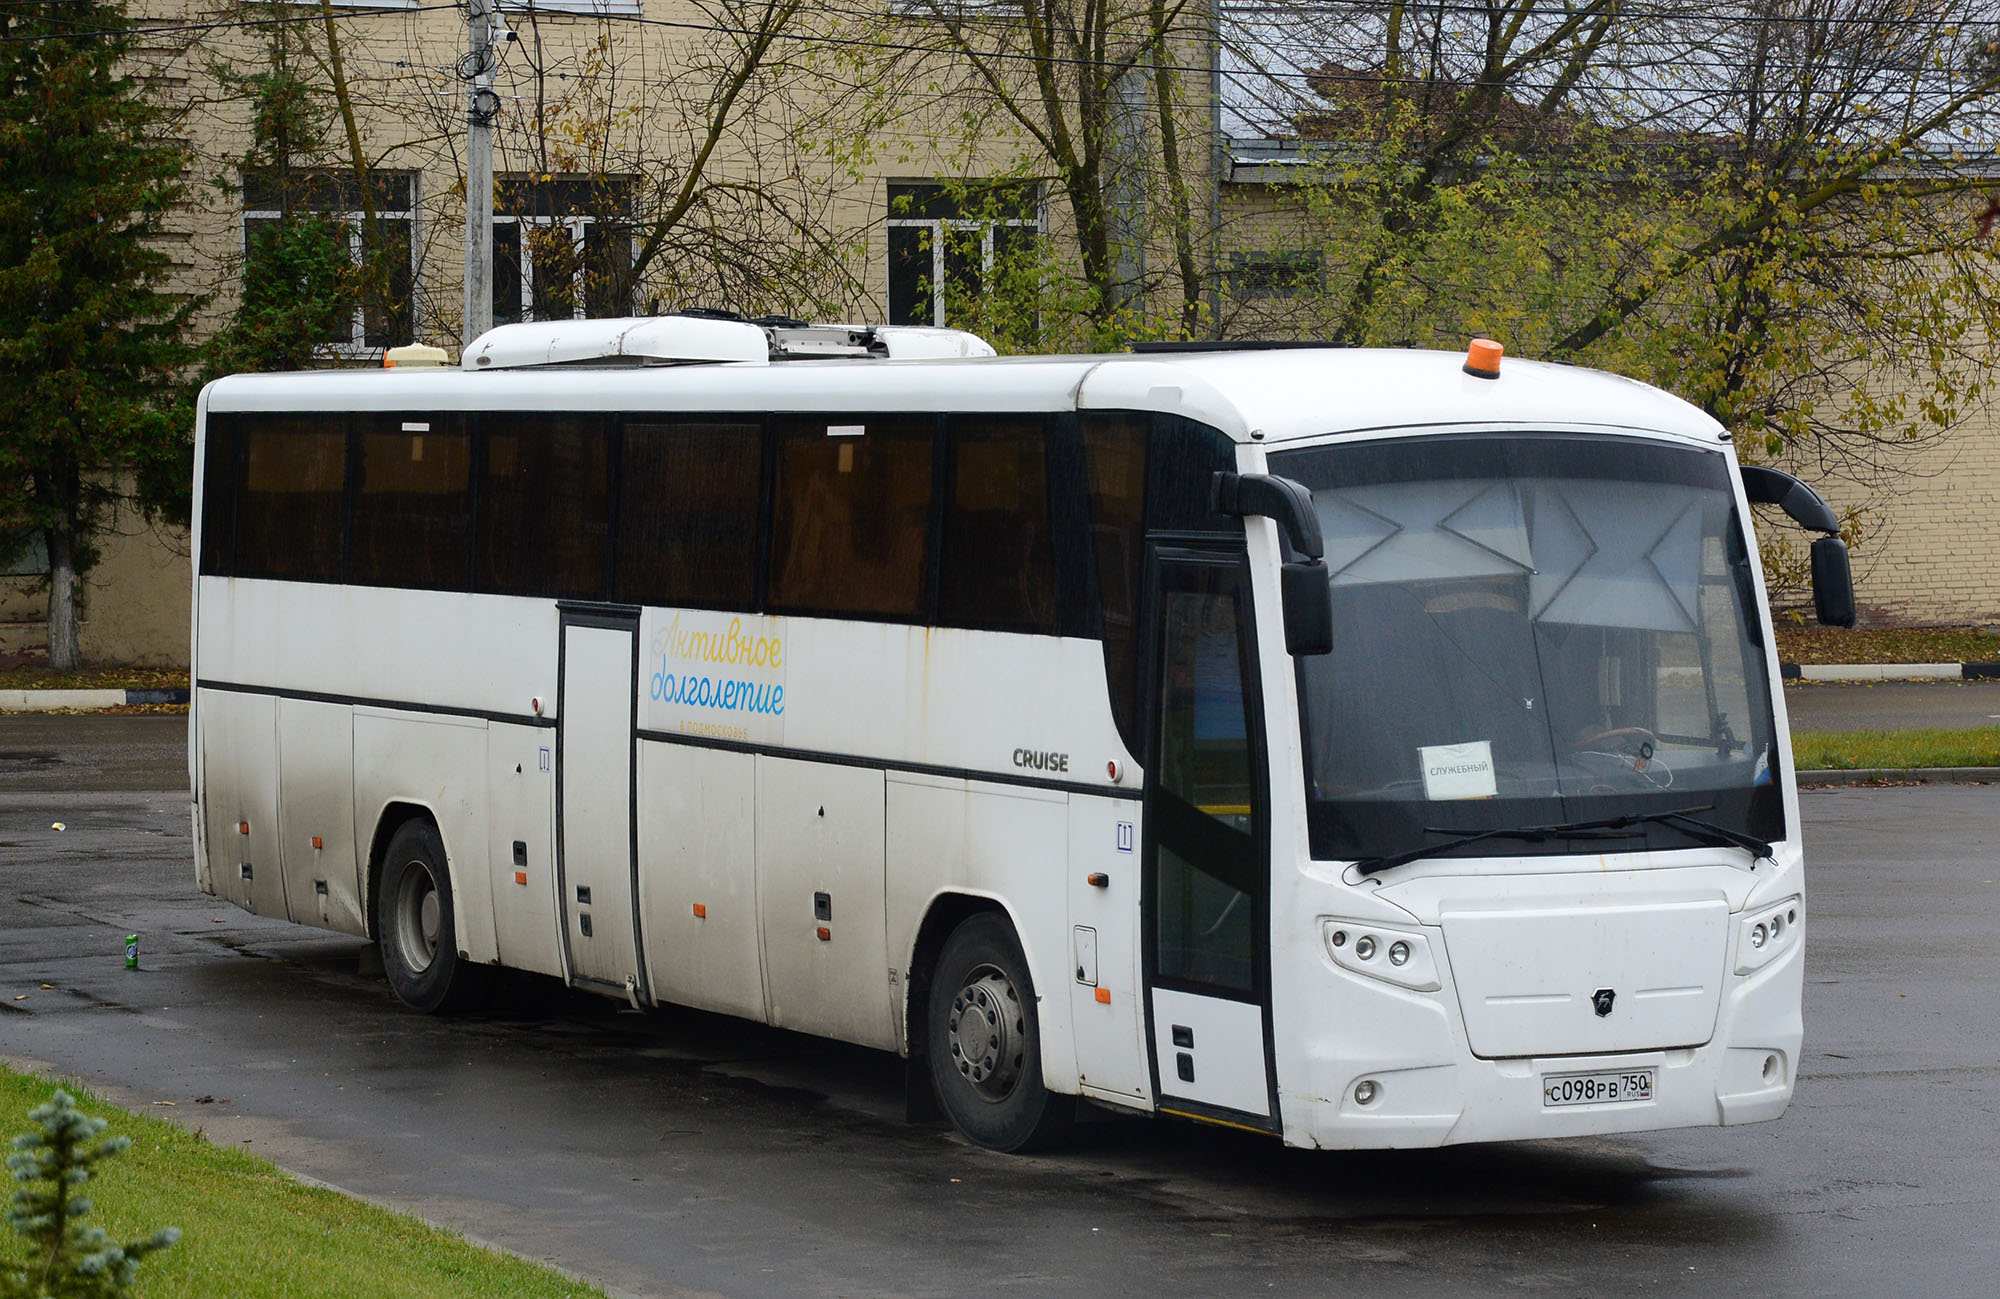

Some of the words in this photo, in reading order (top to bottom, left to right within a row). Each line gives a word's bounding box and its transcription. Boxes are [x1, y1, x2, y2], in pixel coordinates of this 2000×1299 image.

[652, 610, 782, 668] Активное
[687, 721, 748, 740] ПОДМОСКОВЬЕ
[1013, 748, 1069, 772] CRUISE
[1430, 761, 1489, 776] СЛУЖЕБНЫЙ
[1621, 1075, 1647, 1092] 750
